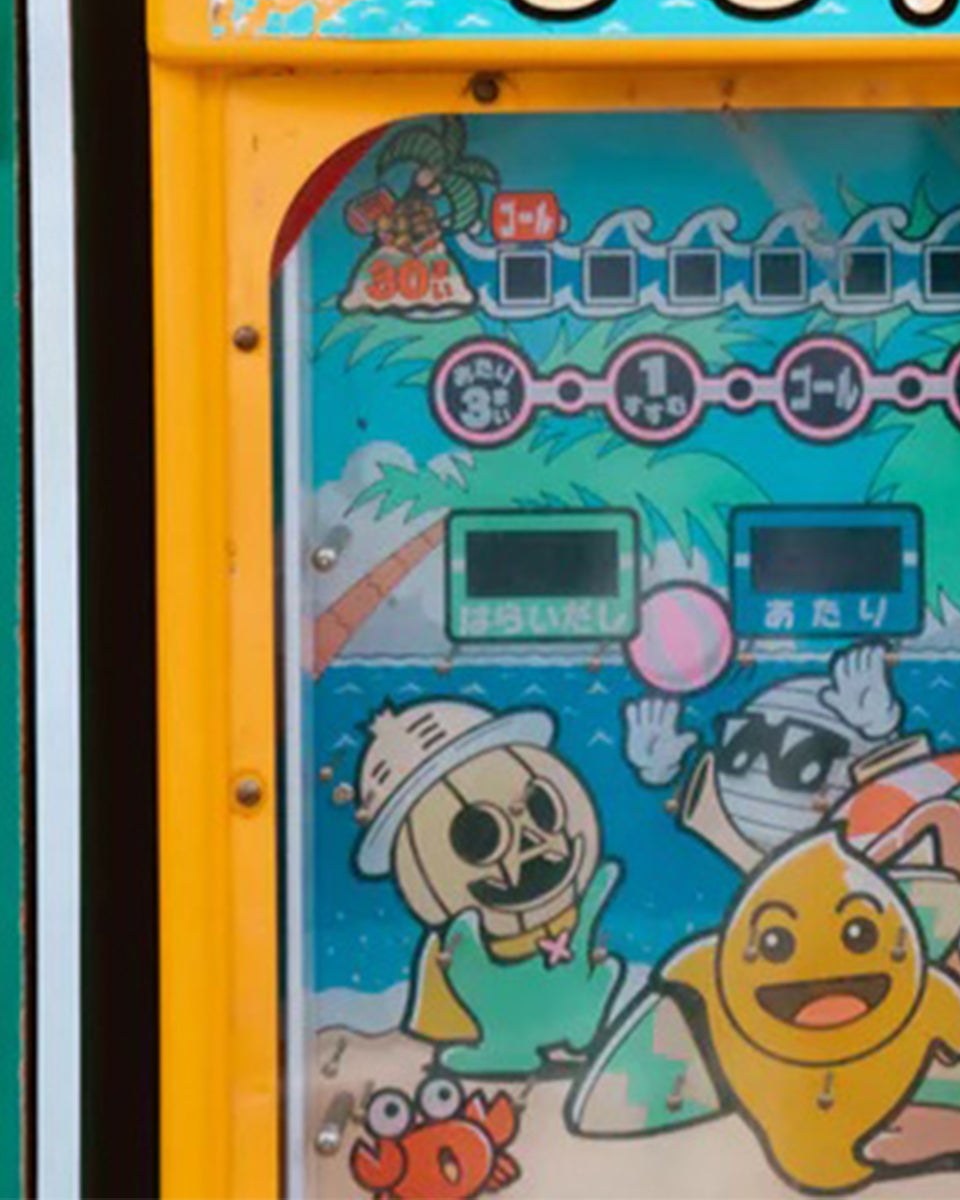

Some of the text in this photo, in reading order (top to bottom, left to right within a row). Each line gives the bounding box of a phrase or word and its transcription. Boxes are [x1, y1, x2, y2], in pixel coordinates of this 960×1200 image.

[459, 599, 629, 637] はらいだし
[764, 596, 887, 629] あたり
